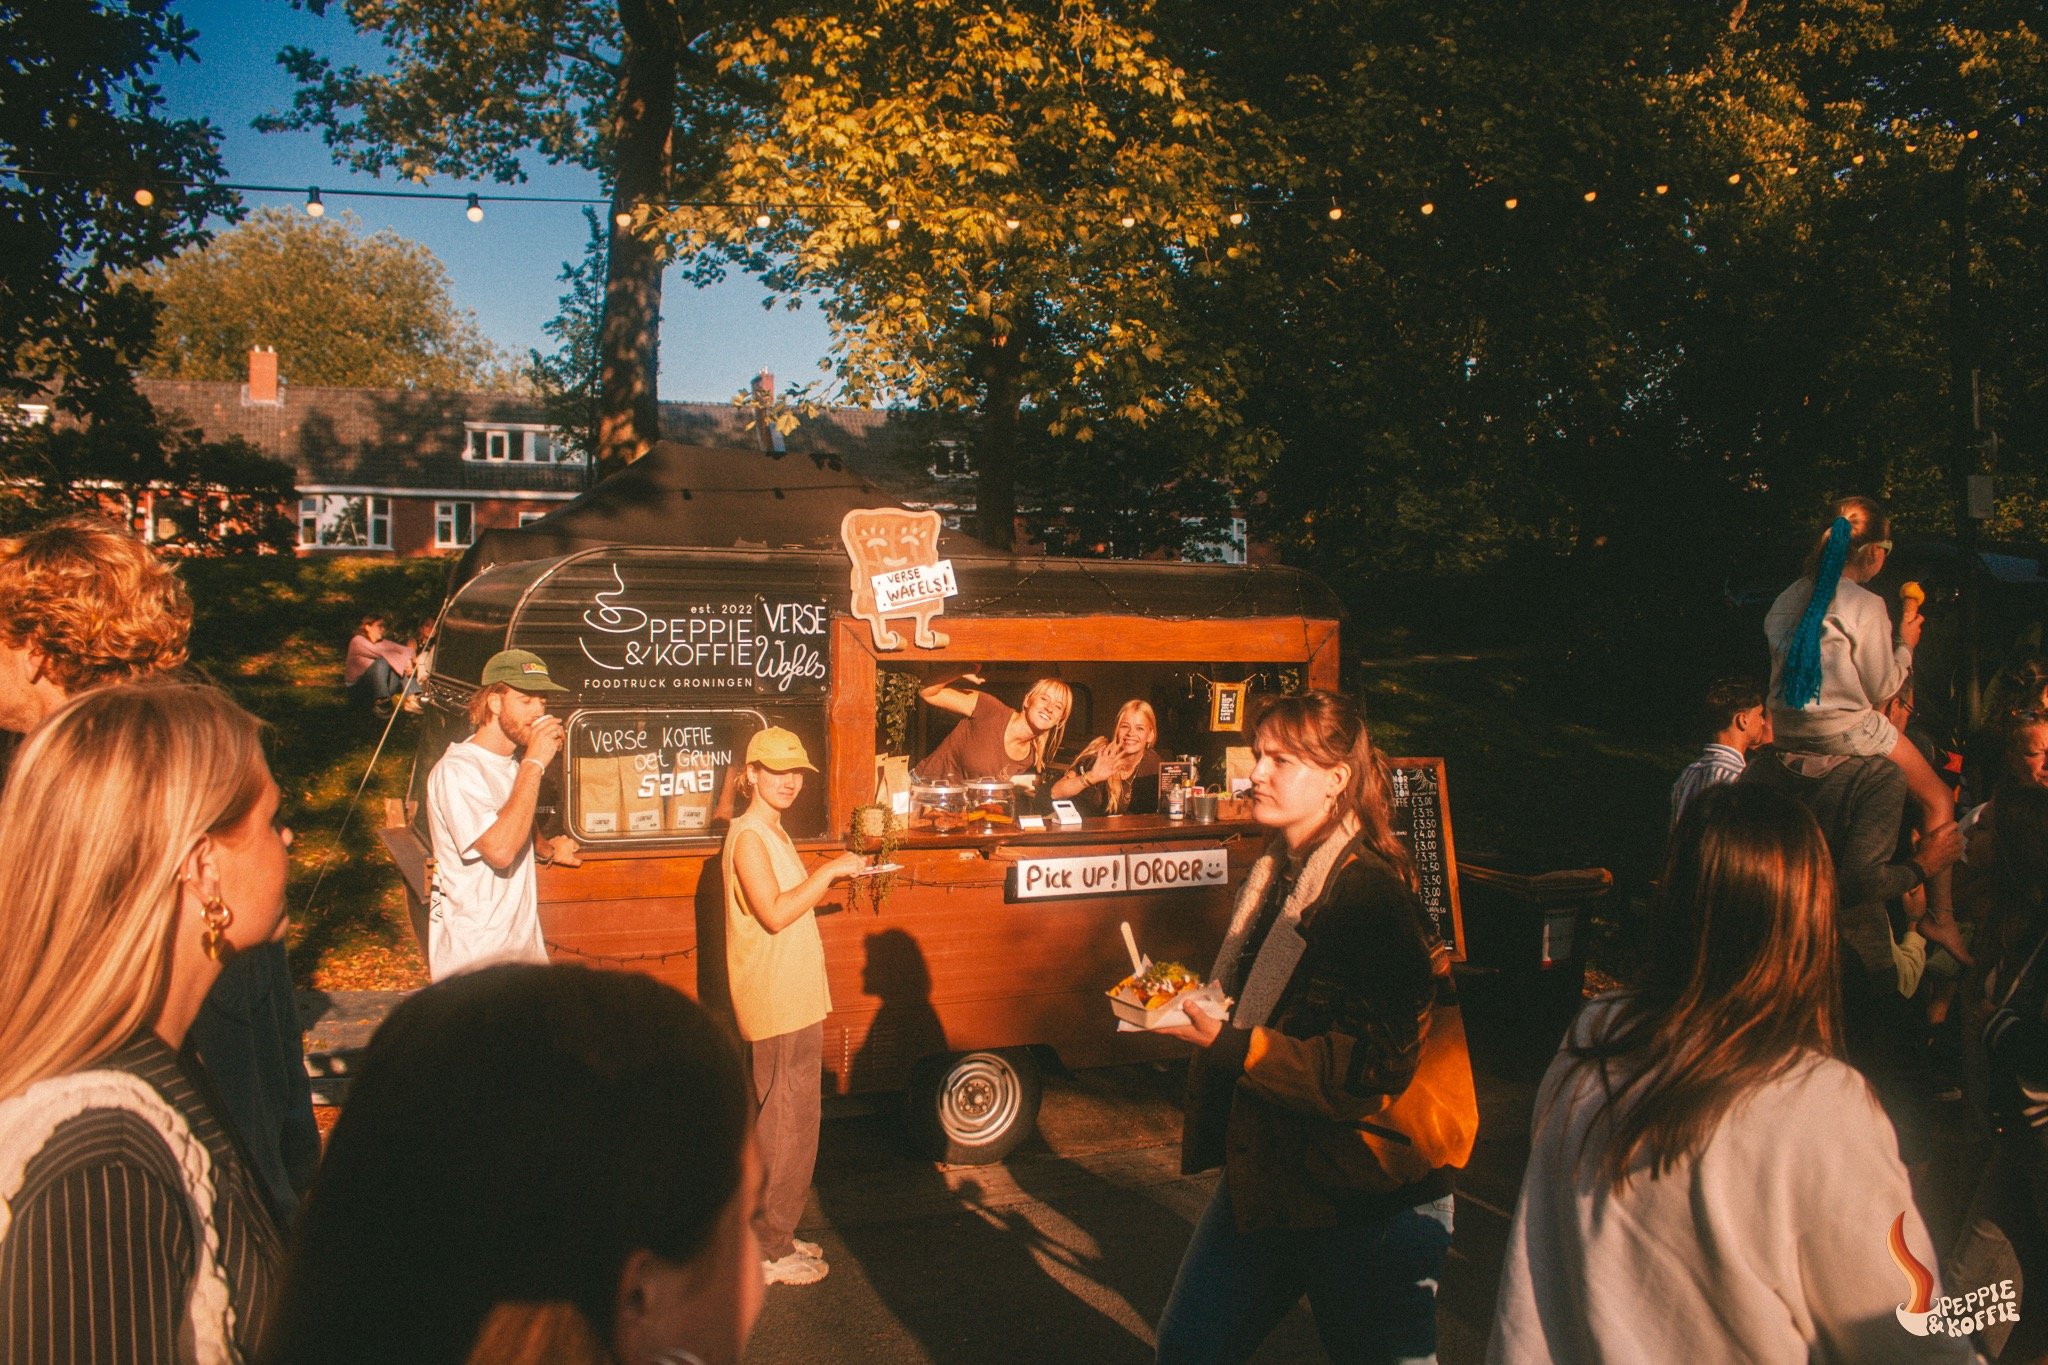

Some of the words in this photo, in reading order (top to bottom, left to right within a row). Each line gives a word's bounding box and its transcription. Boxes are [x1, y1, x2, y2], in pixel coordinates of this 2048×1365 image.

[887, 568, 921, 583] VERSE
[886, 573, 949, 602] WAFELS!
[690, 604, 715, 614] est.
[722, 604, 752, 614] 2022
[763, 603, 826, 634] VERSE
[650, 619, 752, 643] PEPPIE
[755, 635, 826, 692] Wafels
[584, 678, 666, 689] FOODTRUCK
[673, 677, 752, 688] GRONINGEN
[662, 727, 714, 748] KOFFIE
[677, 748, 732, 767] GRUNN
[1082, 859, 1120, 889] UP!
